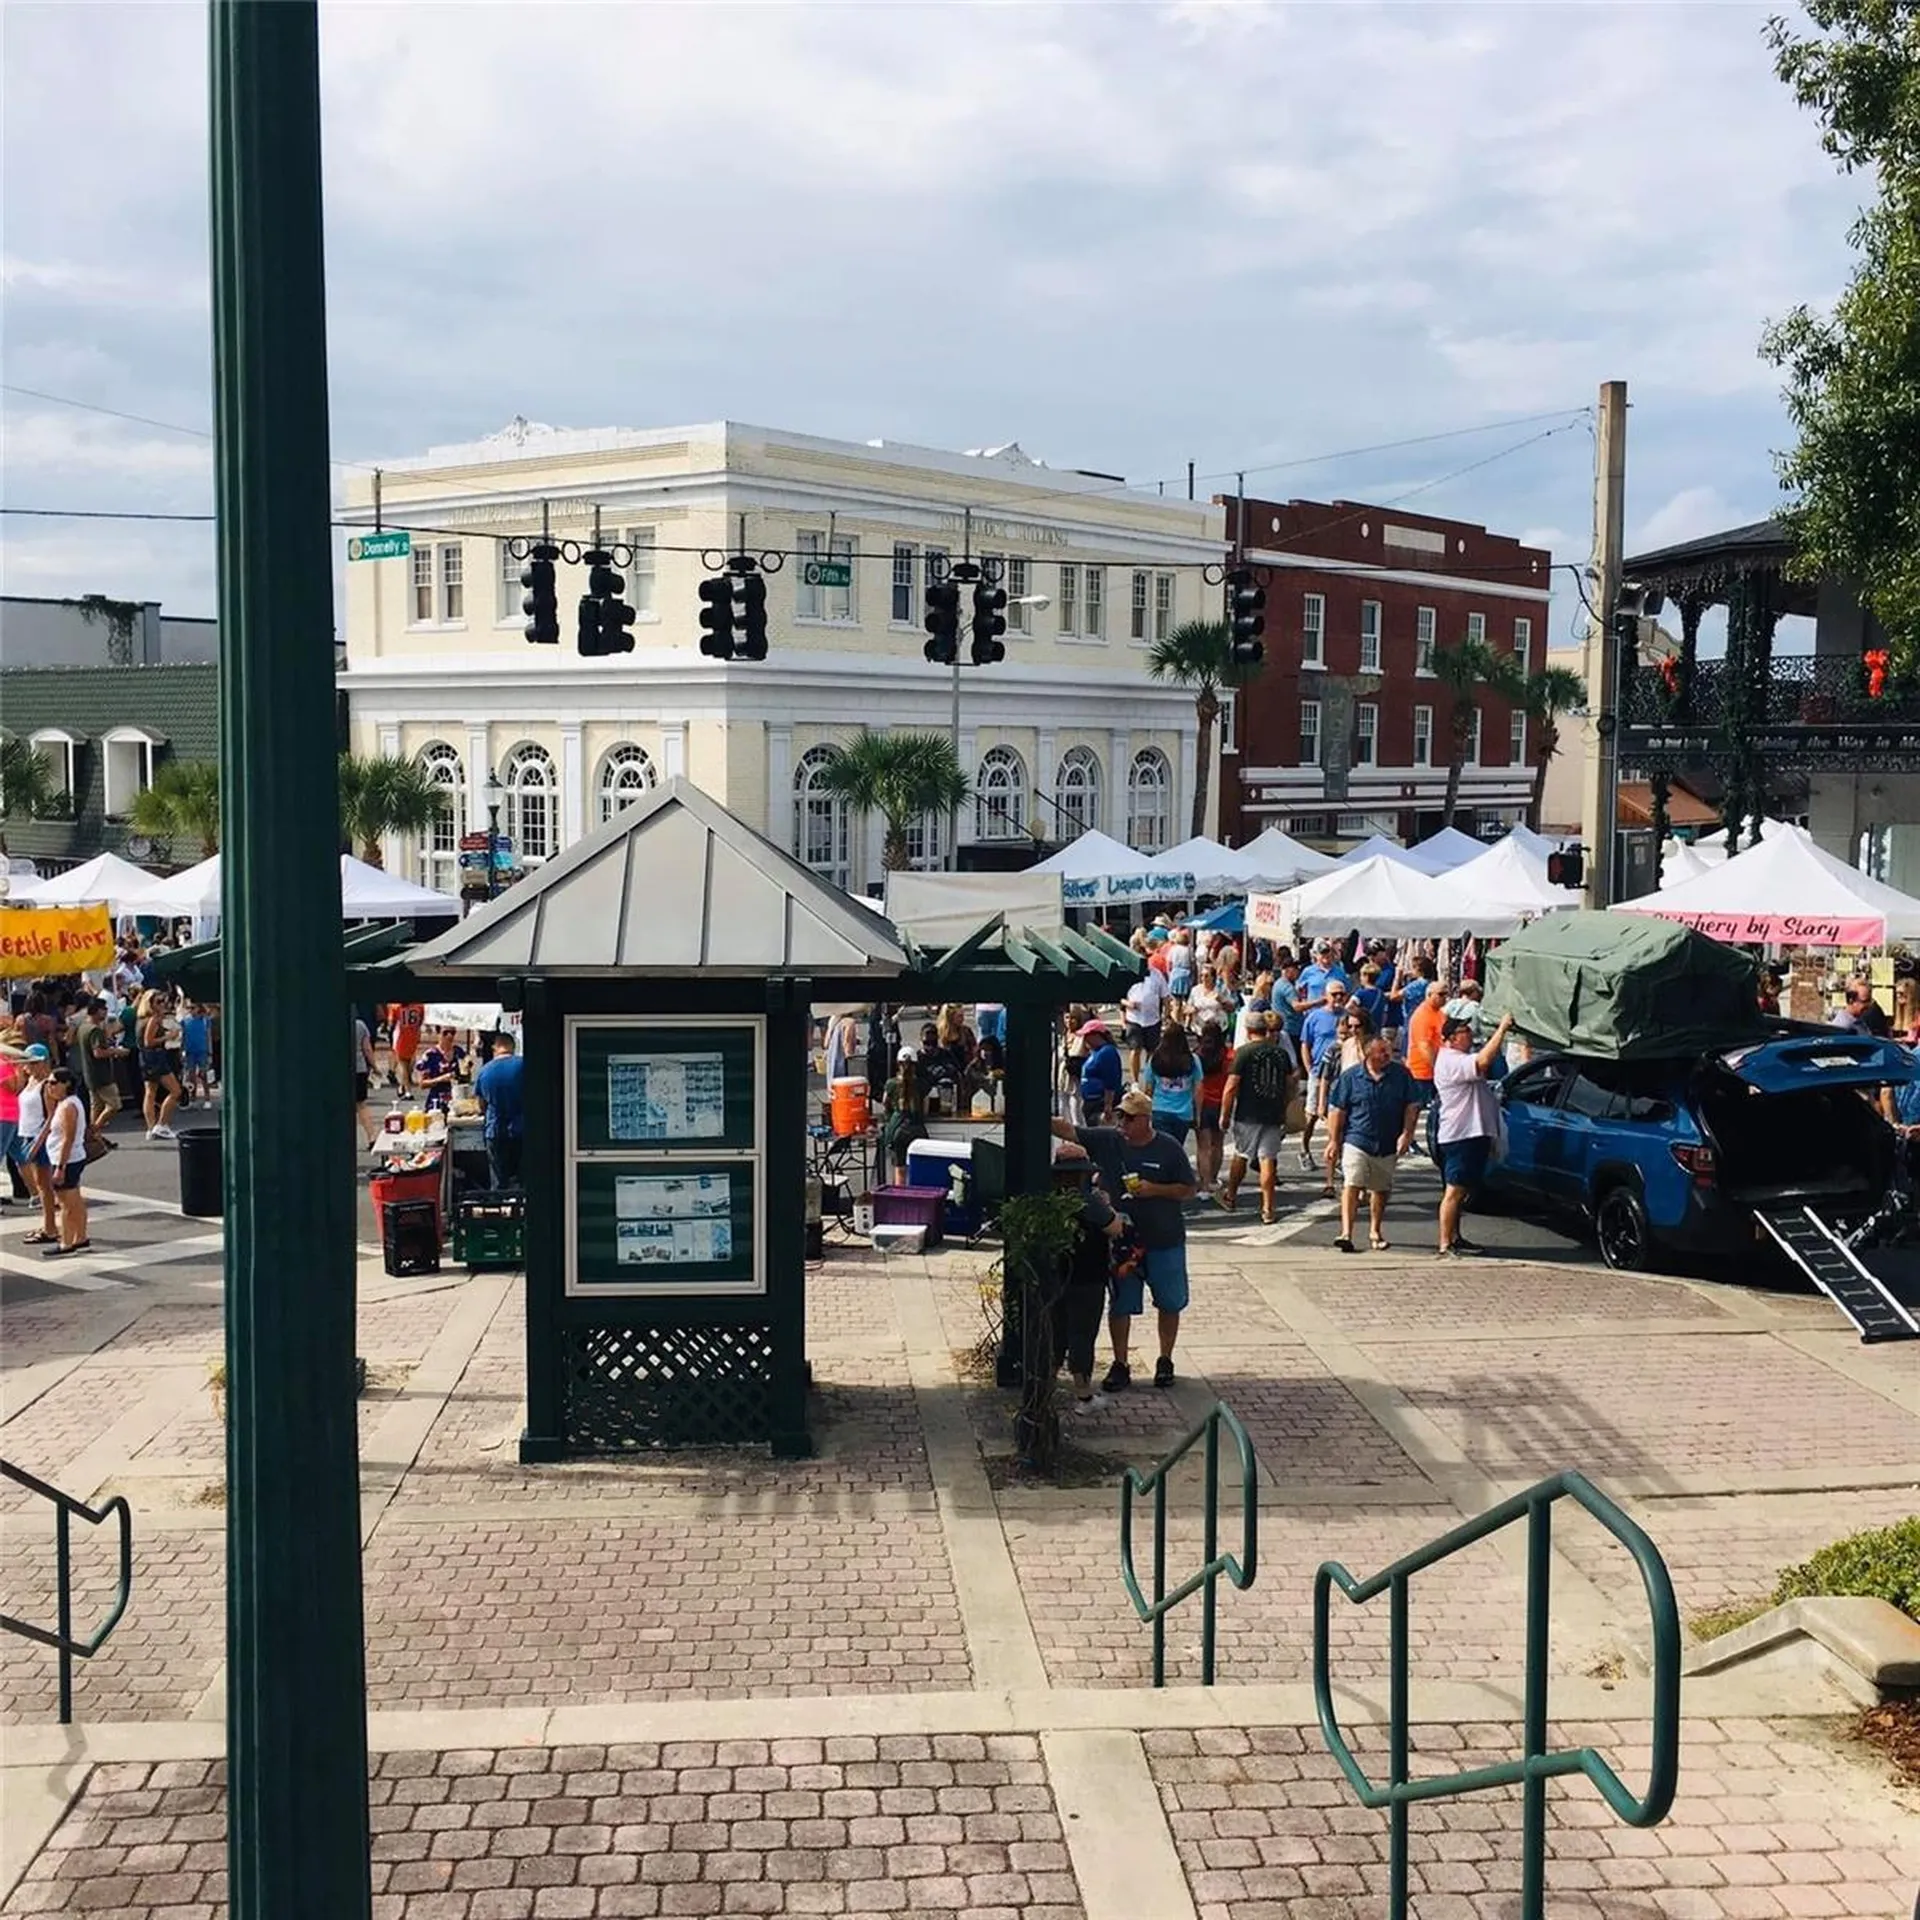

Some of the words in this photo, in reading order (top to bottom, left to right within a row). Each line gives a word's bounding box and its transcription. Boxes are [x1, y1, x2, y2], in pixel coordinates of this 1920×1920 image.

[364, 539, 399, 556] Donnelly
[1653, 911, 1738, 939] chery
[1746, 915, 1770, 941] by
[1780, 916, 1840, 942] Stacy
[0, 929, 52, 959] ettle
